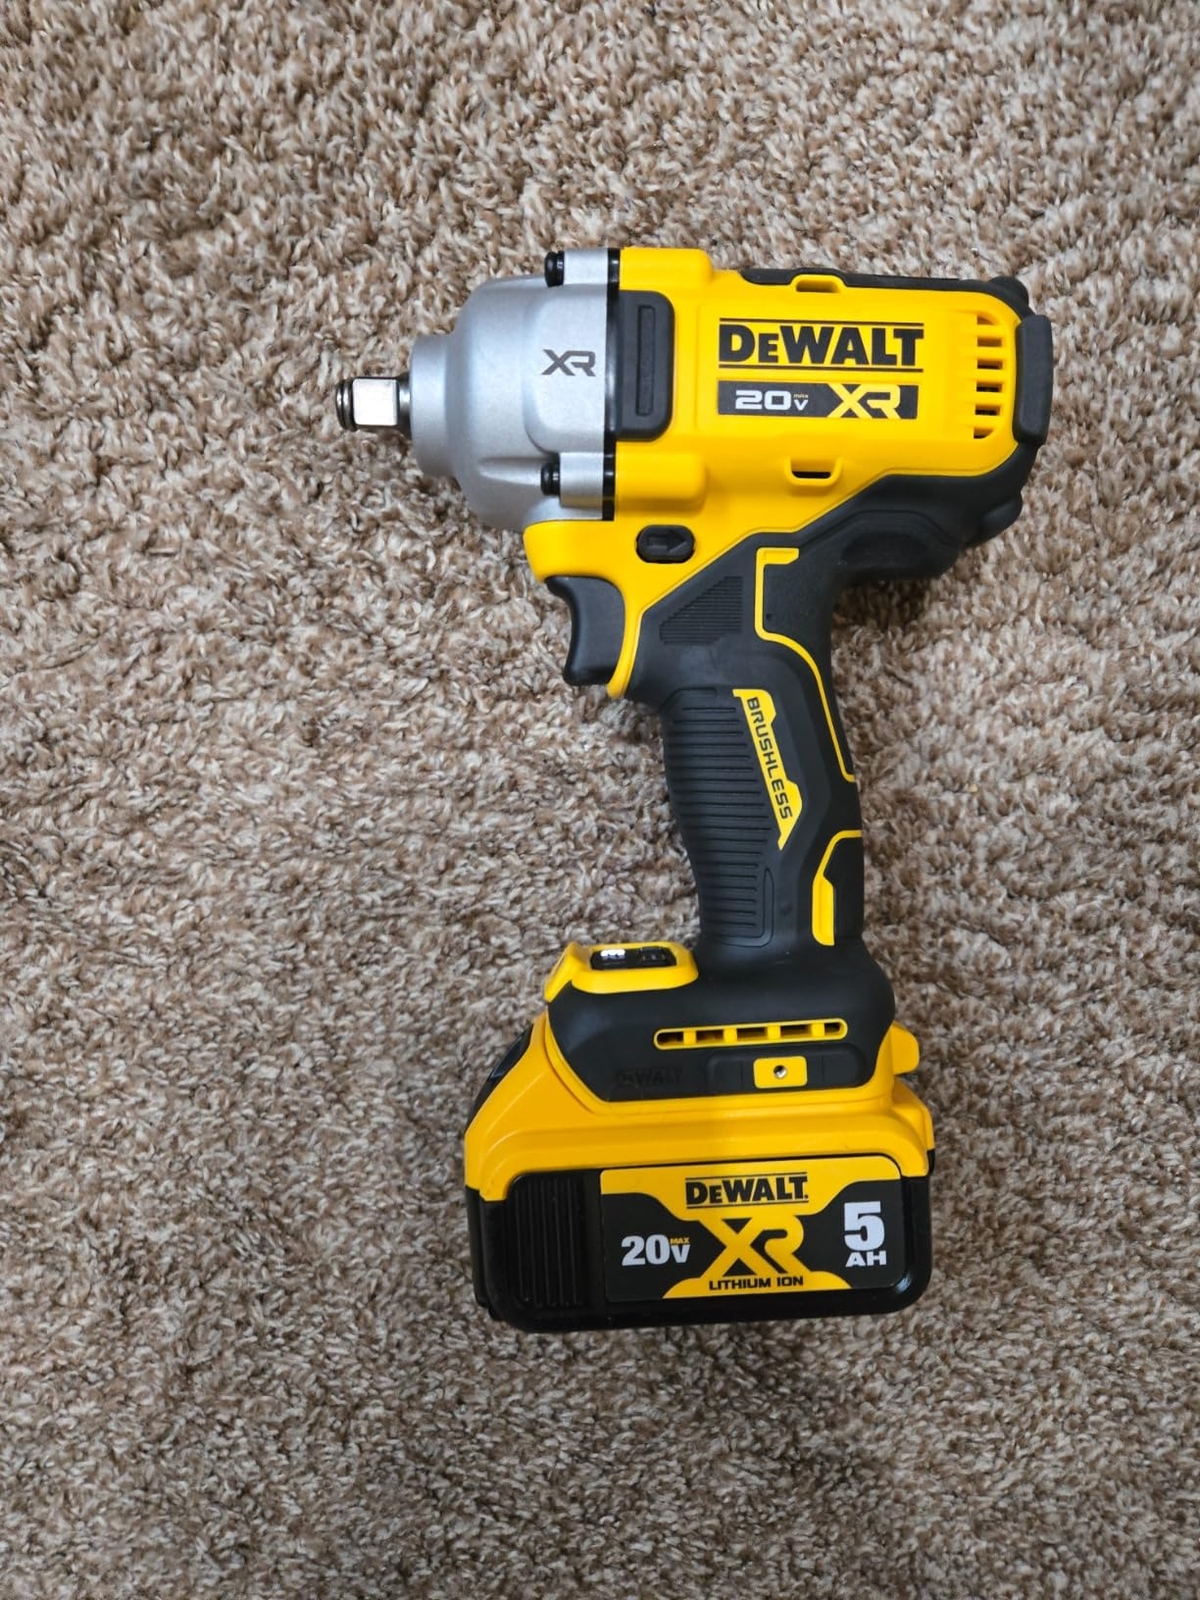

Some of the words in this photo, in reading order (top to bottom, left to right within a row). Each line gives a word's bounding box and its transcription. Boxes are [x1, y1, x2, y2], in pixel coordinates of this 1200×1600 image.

[541, 349, 597, 376] XR
[719, 324, 924, 366] DEWALT
[827, 383, 901, 419] XR
[747, 697, 793, 819] BRUSHLESS
[698, 1214, 813, 1276] XR
[844, 1201, 885, 1251] 5
[845, 1251, 887, 1267] AH
[709, 1277, 771, 1291] LITHIUM
[776, 1276, 804, 1288] ION
